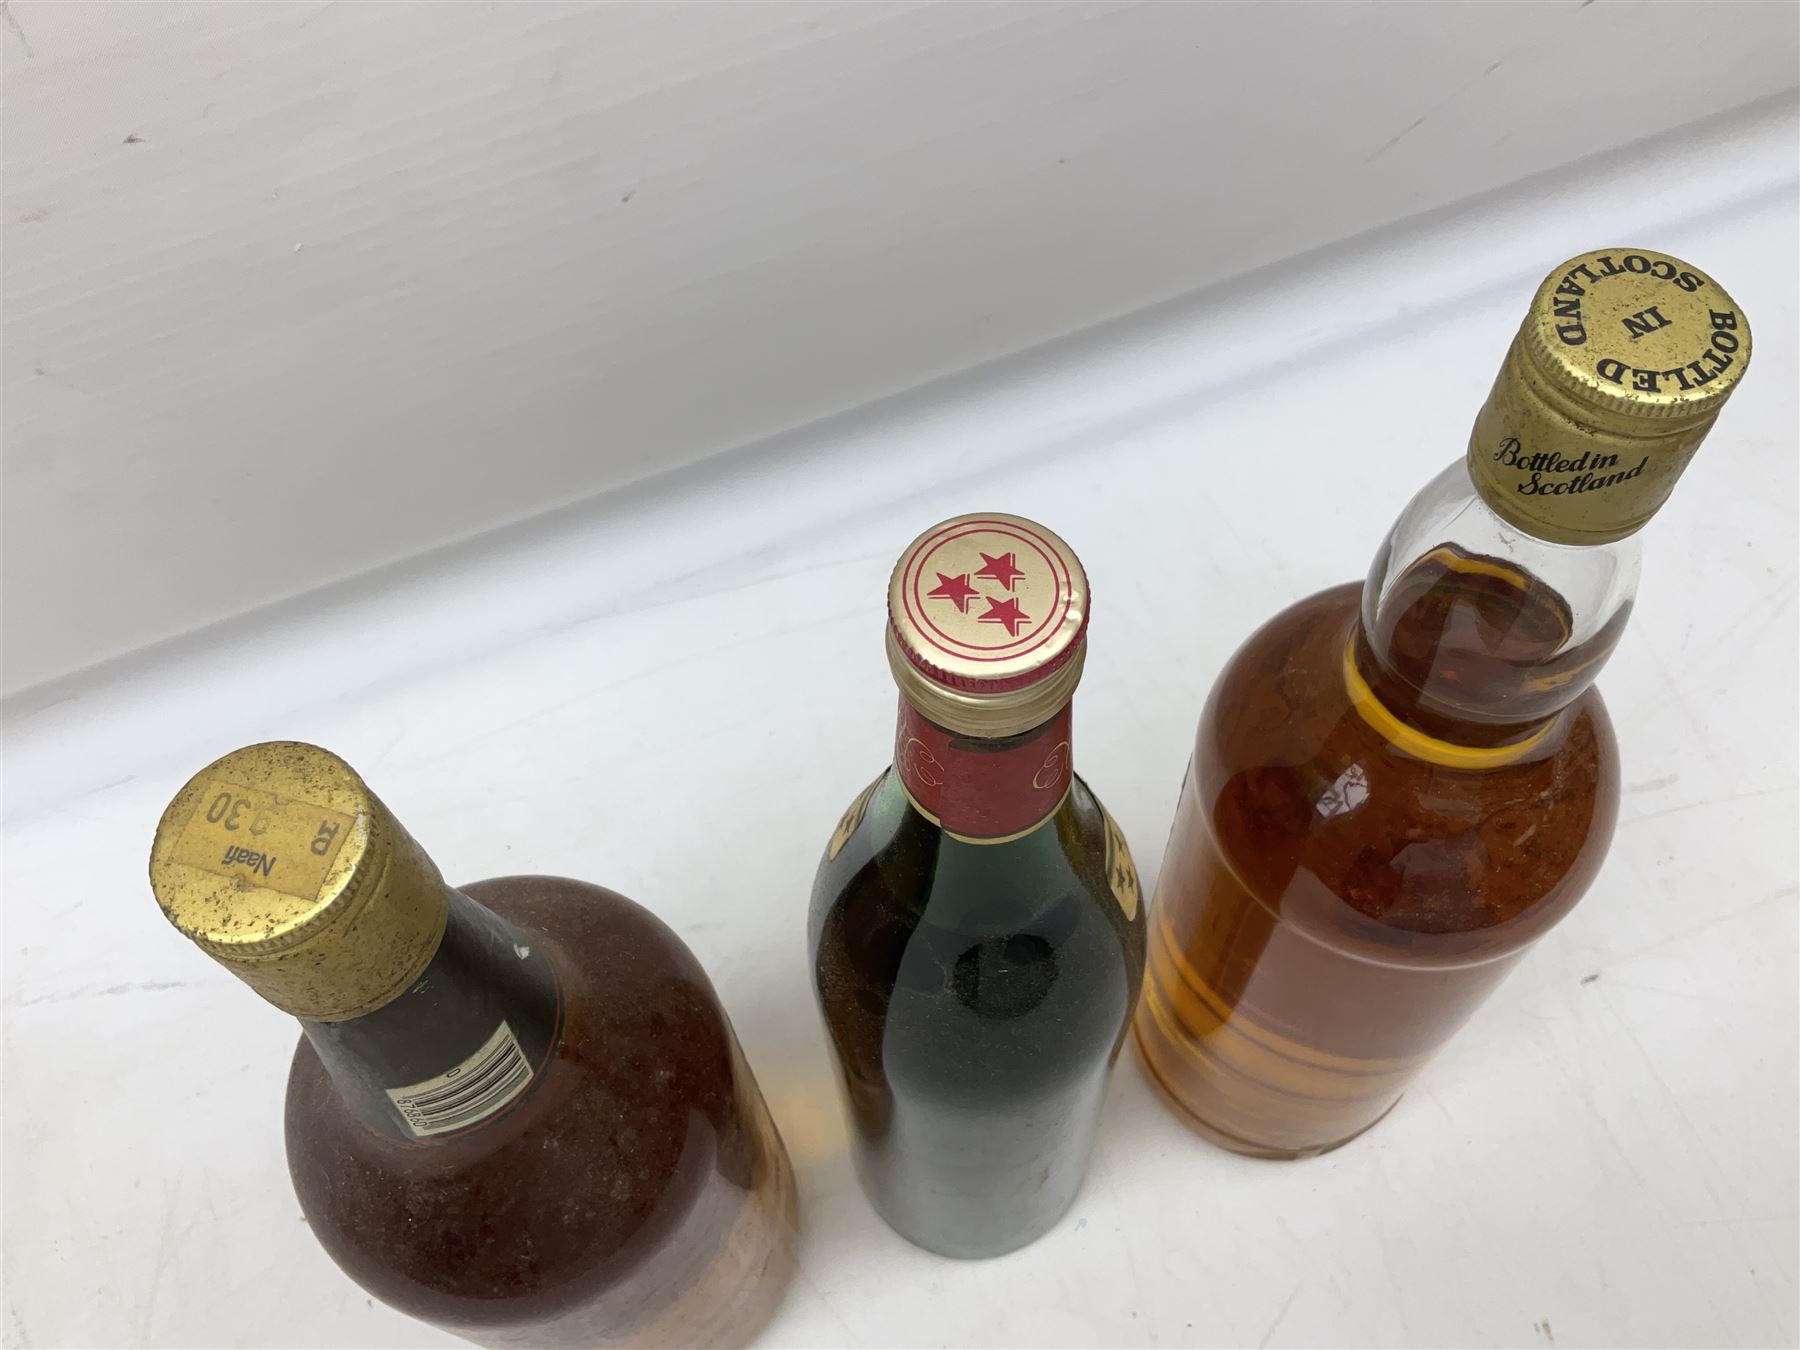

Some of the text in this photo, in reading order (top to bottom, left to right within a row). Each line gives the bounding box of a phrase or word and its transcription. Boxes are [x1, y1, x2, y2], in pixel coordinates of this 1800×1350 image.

[1553, 254, 1704, 346] SCOTLAND
[1622, 306, 1672, 340] IN
[1596, 309, 1739, 393] BOTTLED
[1494, 436, 1618, 473] Bottled in
[1518, 456, 1649, 496] Scotland
[221, 845, 277, 876] Naafi
